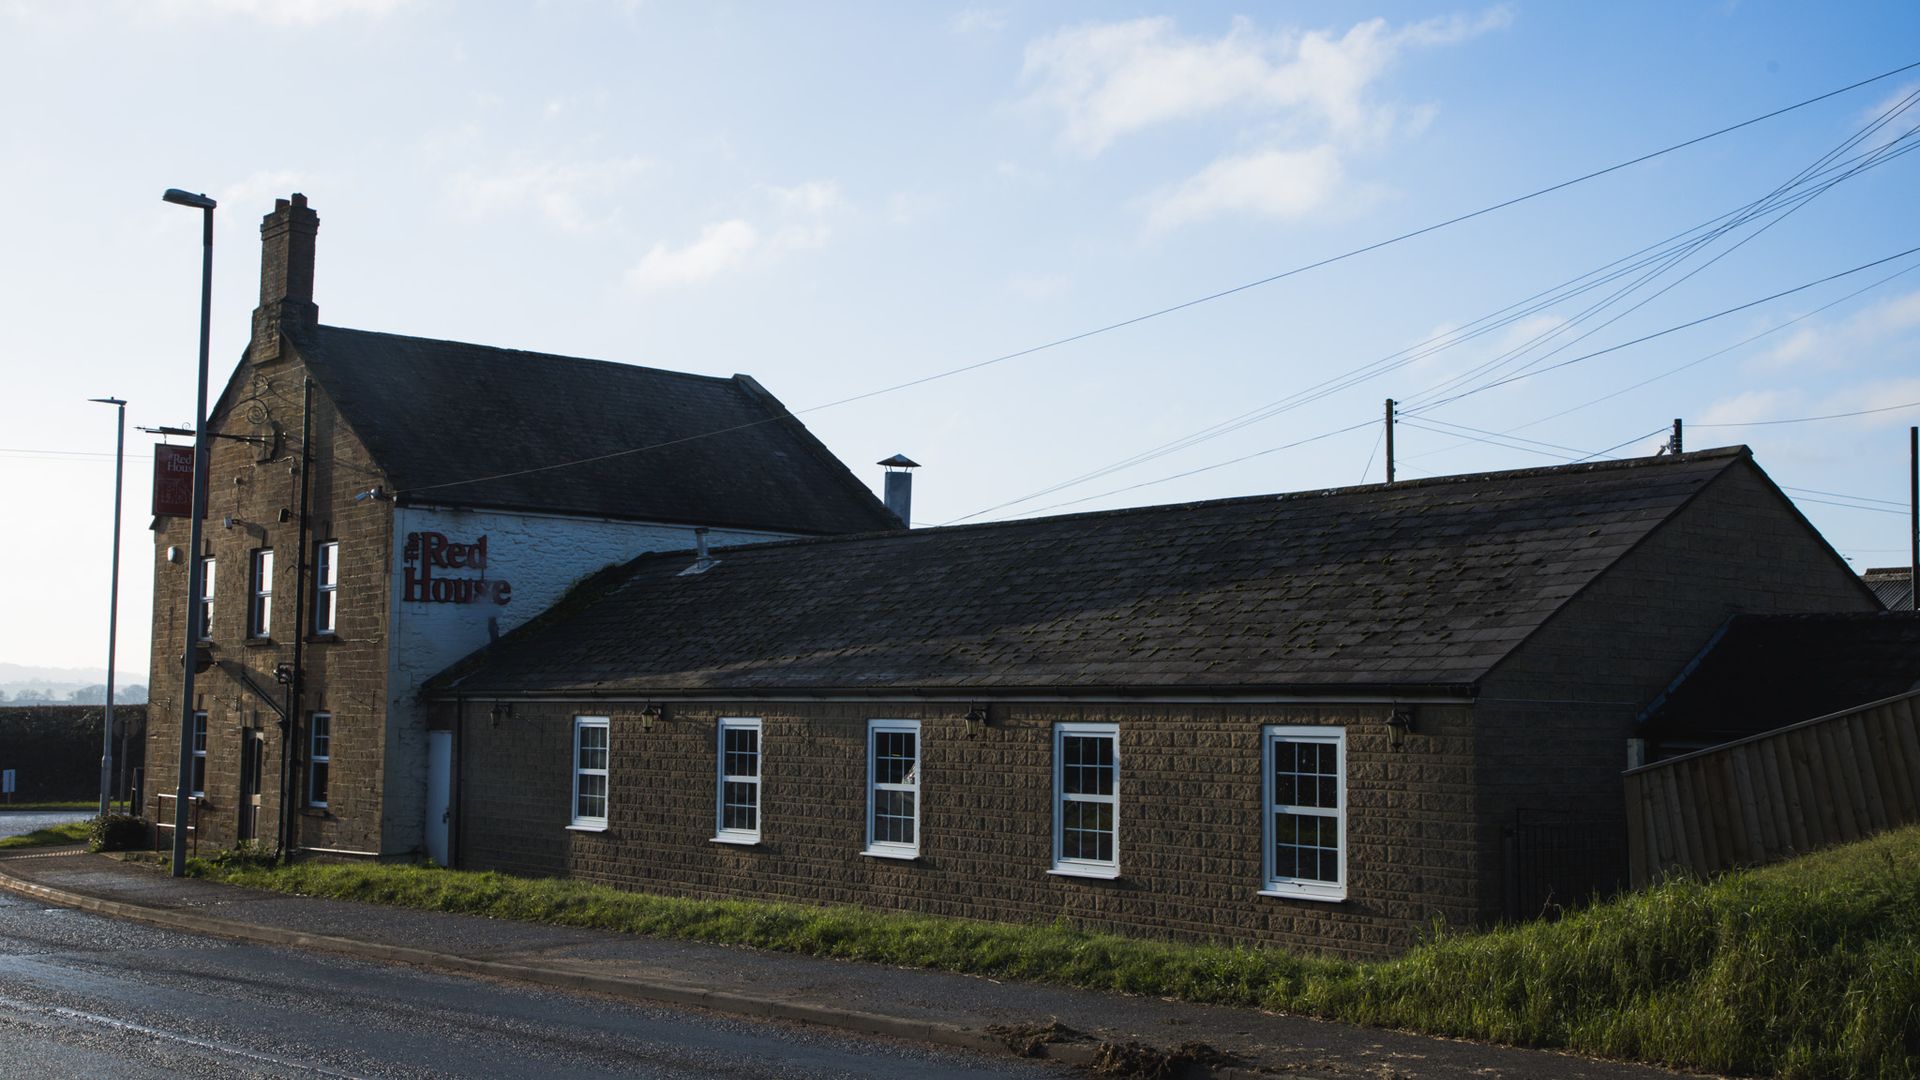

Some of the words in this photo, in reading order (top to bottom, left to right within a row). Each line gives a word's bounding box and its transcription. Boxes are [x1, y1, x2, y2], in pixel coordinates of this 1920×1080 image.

[174, 453, 192, 464] Red
[167, 461, 193, 472] Hous
[420, 532, 487, 569] Red
